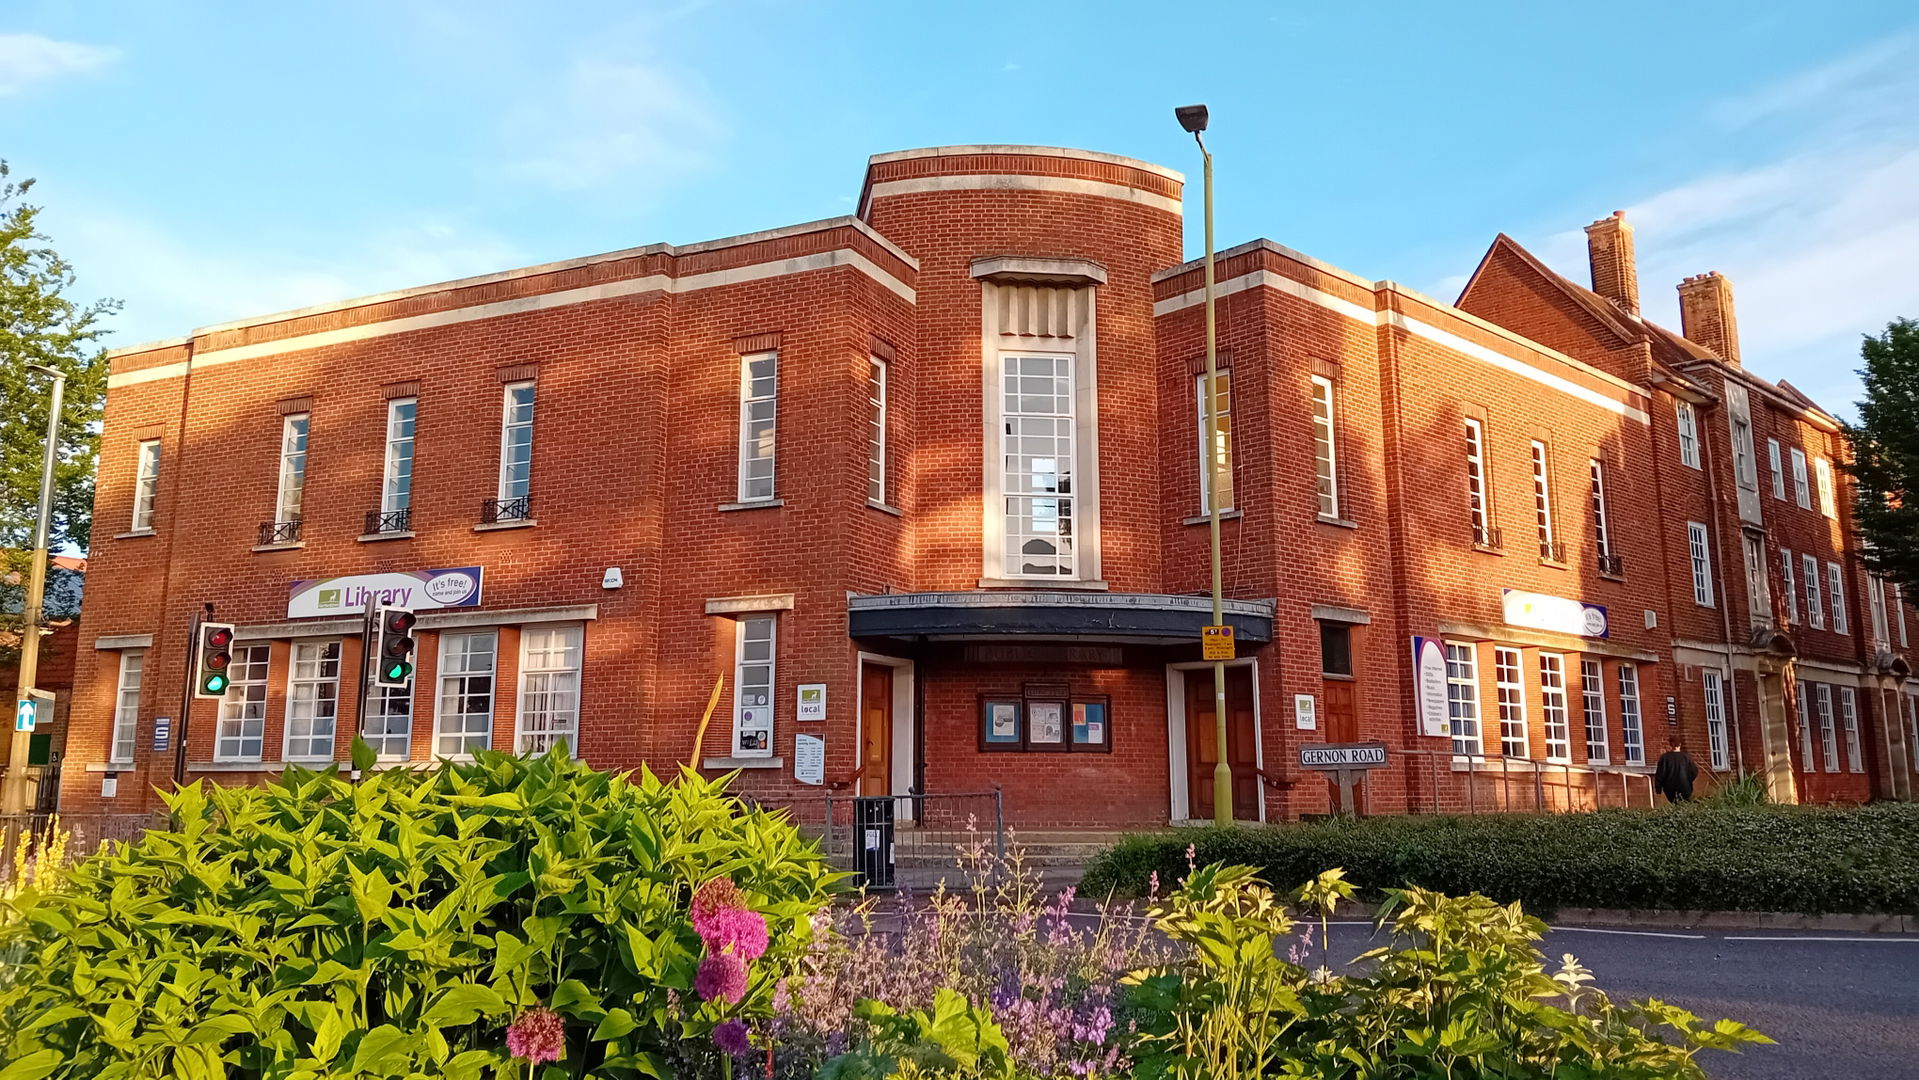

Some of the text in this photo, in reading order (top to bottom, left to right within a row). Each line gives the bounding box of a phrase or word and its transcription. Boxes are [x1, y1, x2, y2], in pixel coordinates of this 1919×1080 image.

[432, 577, 468, 591] It's free!
[345, 586, 412, 607] Library
[801, 705, 821, 713] local
[1302, 749, 1384, 763] GERNON ROAD
